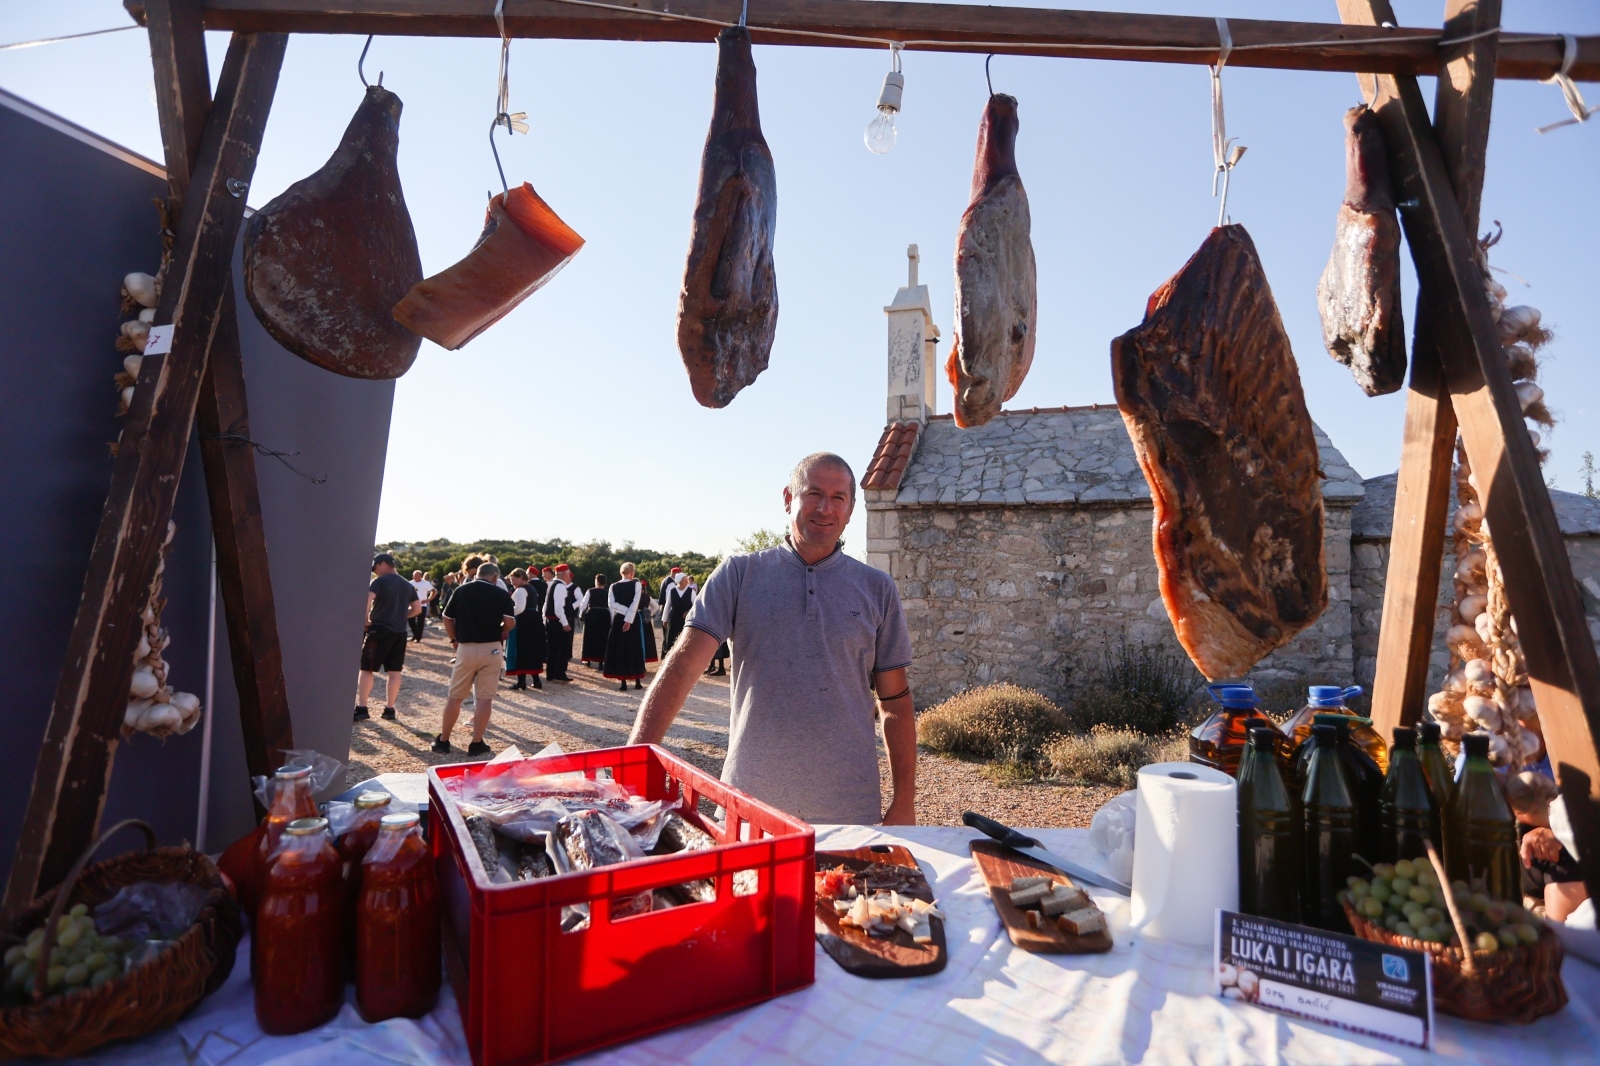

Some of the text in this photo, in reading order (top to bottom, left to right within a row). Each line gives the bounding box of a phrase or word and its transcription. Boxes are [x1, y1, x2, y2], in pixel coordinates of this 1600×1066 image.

[1232, 926, 1352, 960] PARKA PRIRODE VRANSKO JEZERO
[1241, 920, 1264, 931] SAJAM
[1265, 926, 1302, 940] LOKALNIH
[1304, 934, 1346, 950] PROIZVODA
[1231, 936, 1356, 984] LUKA I IGARA
[1376, 981, 1417, 996] VRANSKO
[1381, 990, 1412, 1002] JEZERO
